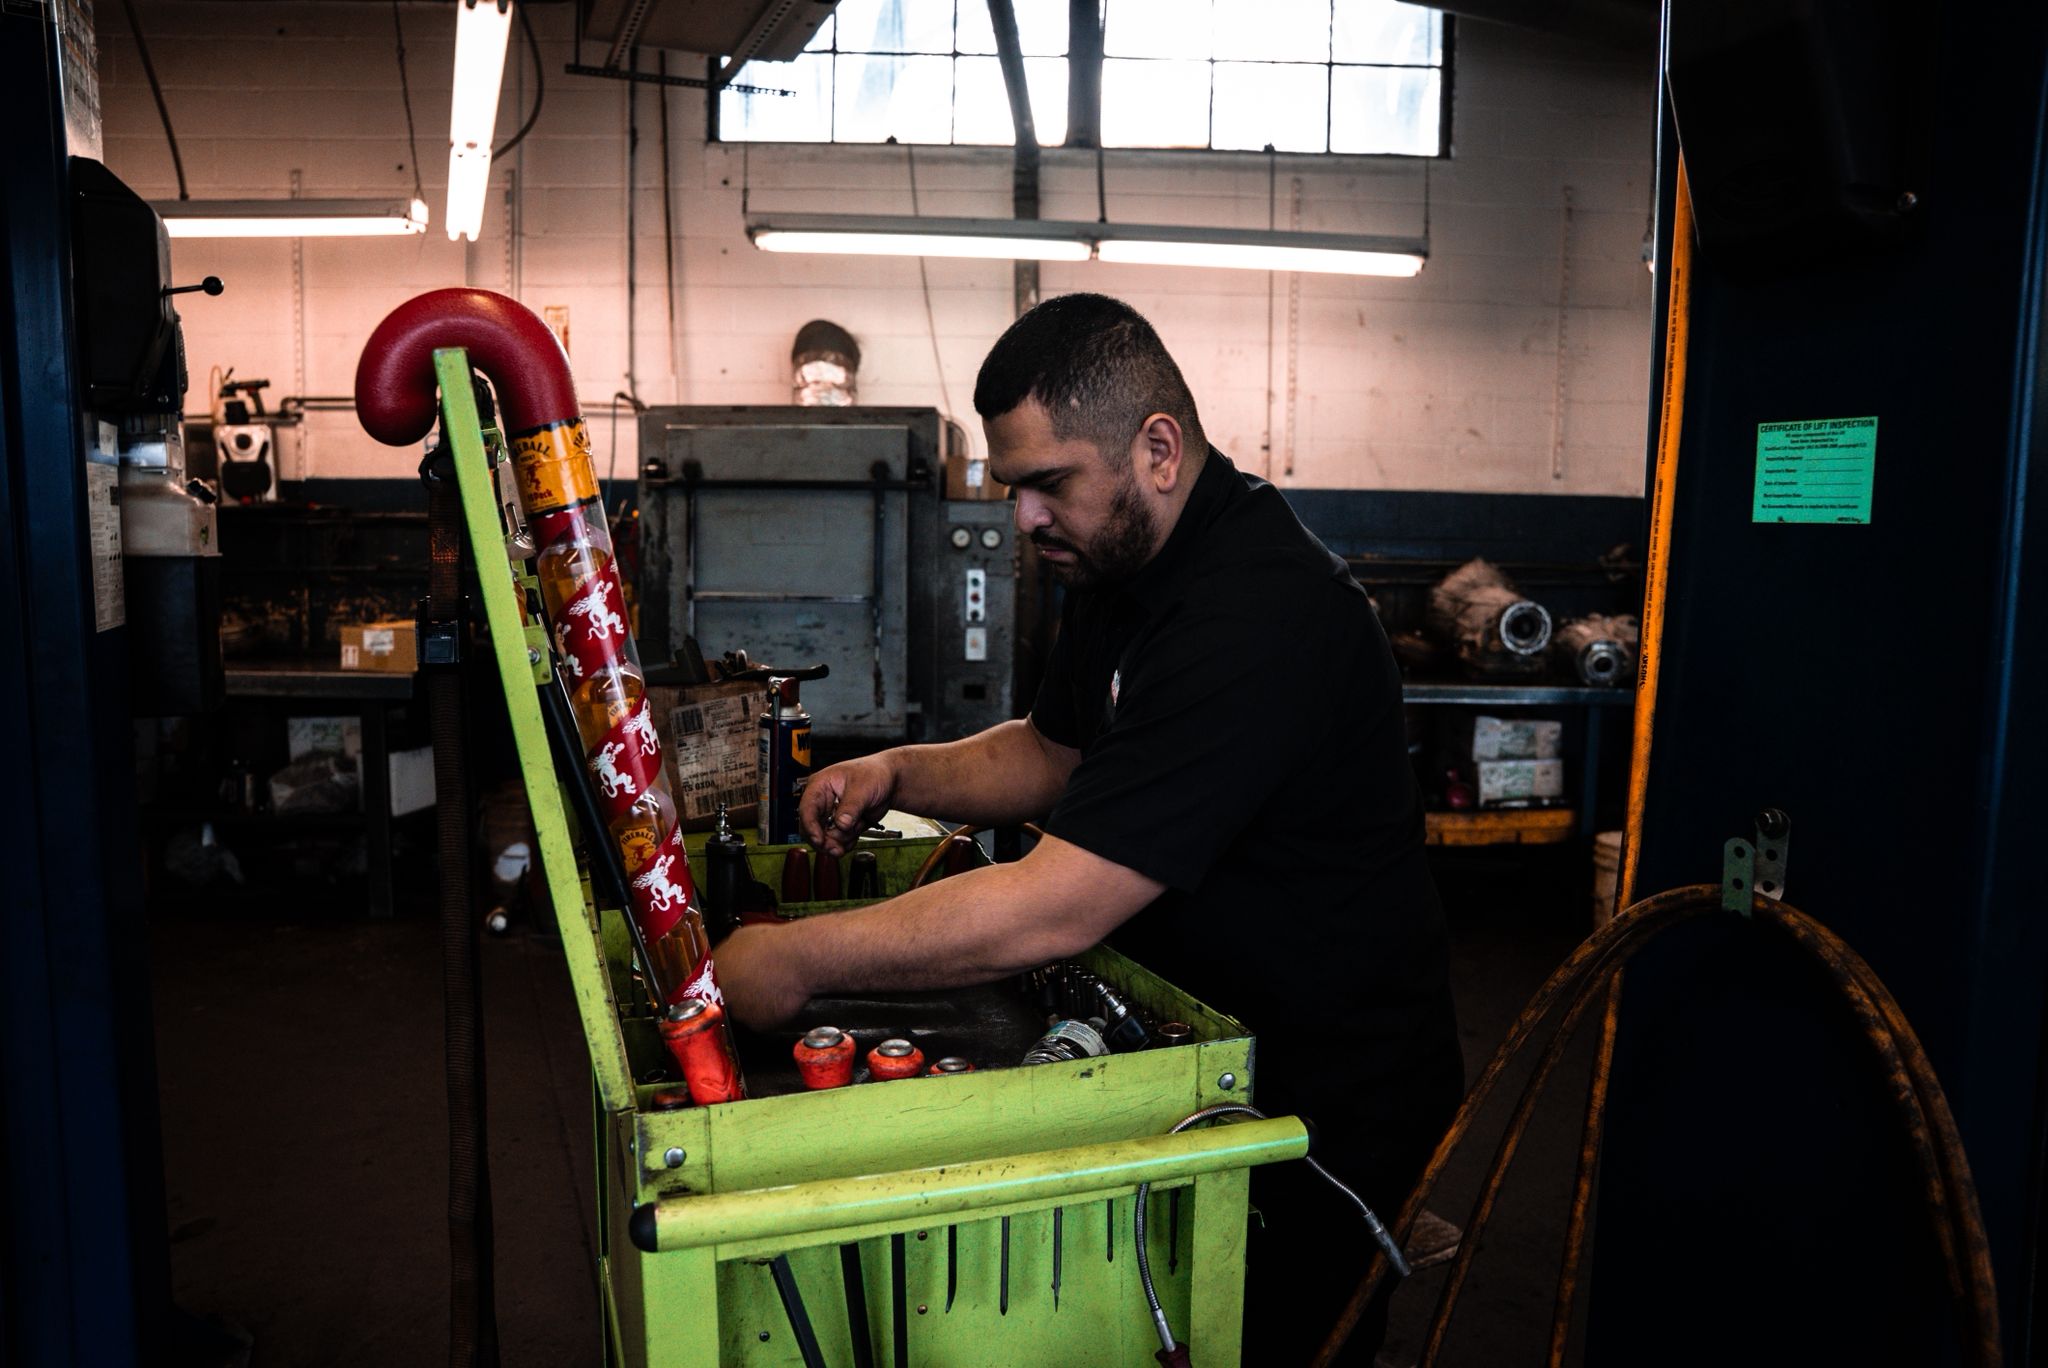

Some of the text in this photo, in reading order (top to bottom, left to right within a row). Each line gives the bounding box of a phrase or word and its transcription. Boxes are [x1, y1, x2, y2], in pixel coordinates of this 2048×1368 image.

[1760, 419, 1875, 433] CERTIFICATE OF LIFT INSPECTION
[1640, 654, 1649, 681] HUSKY
[621, 831, 656, 845] FIREBALL
